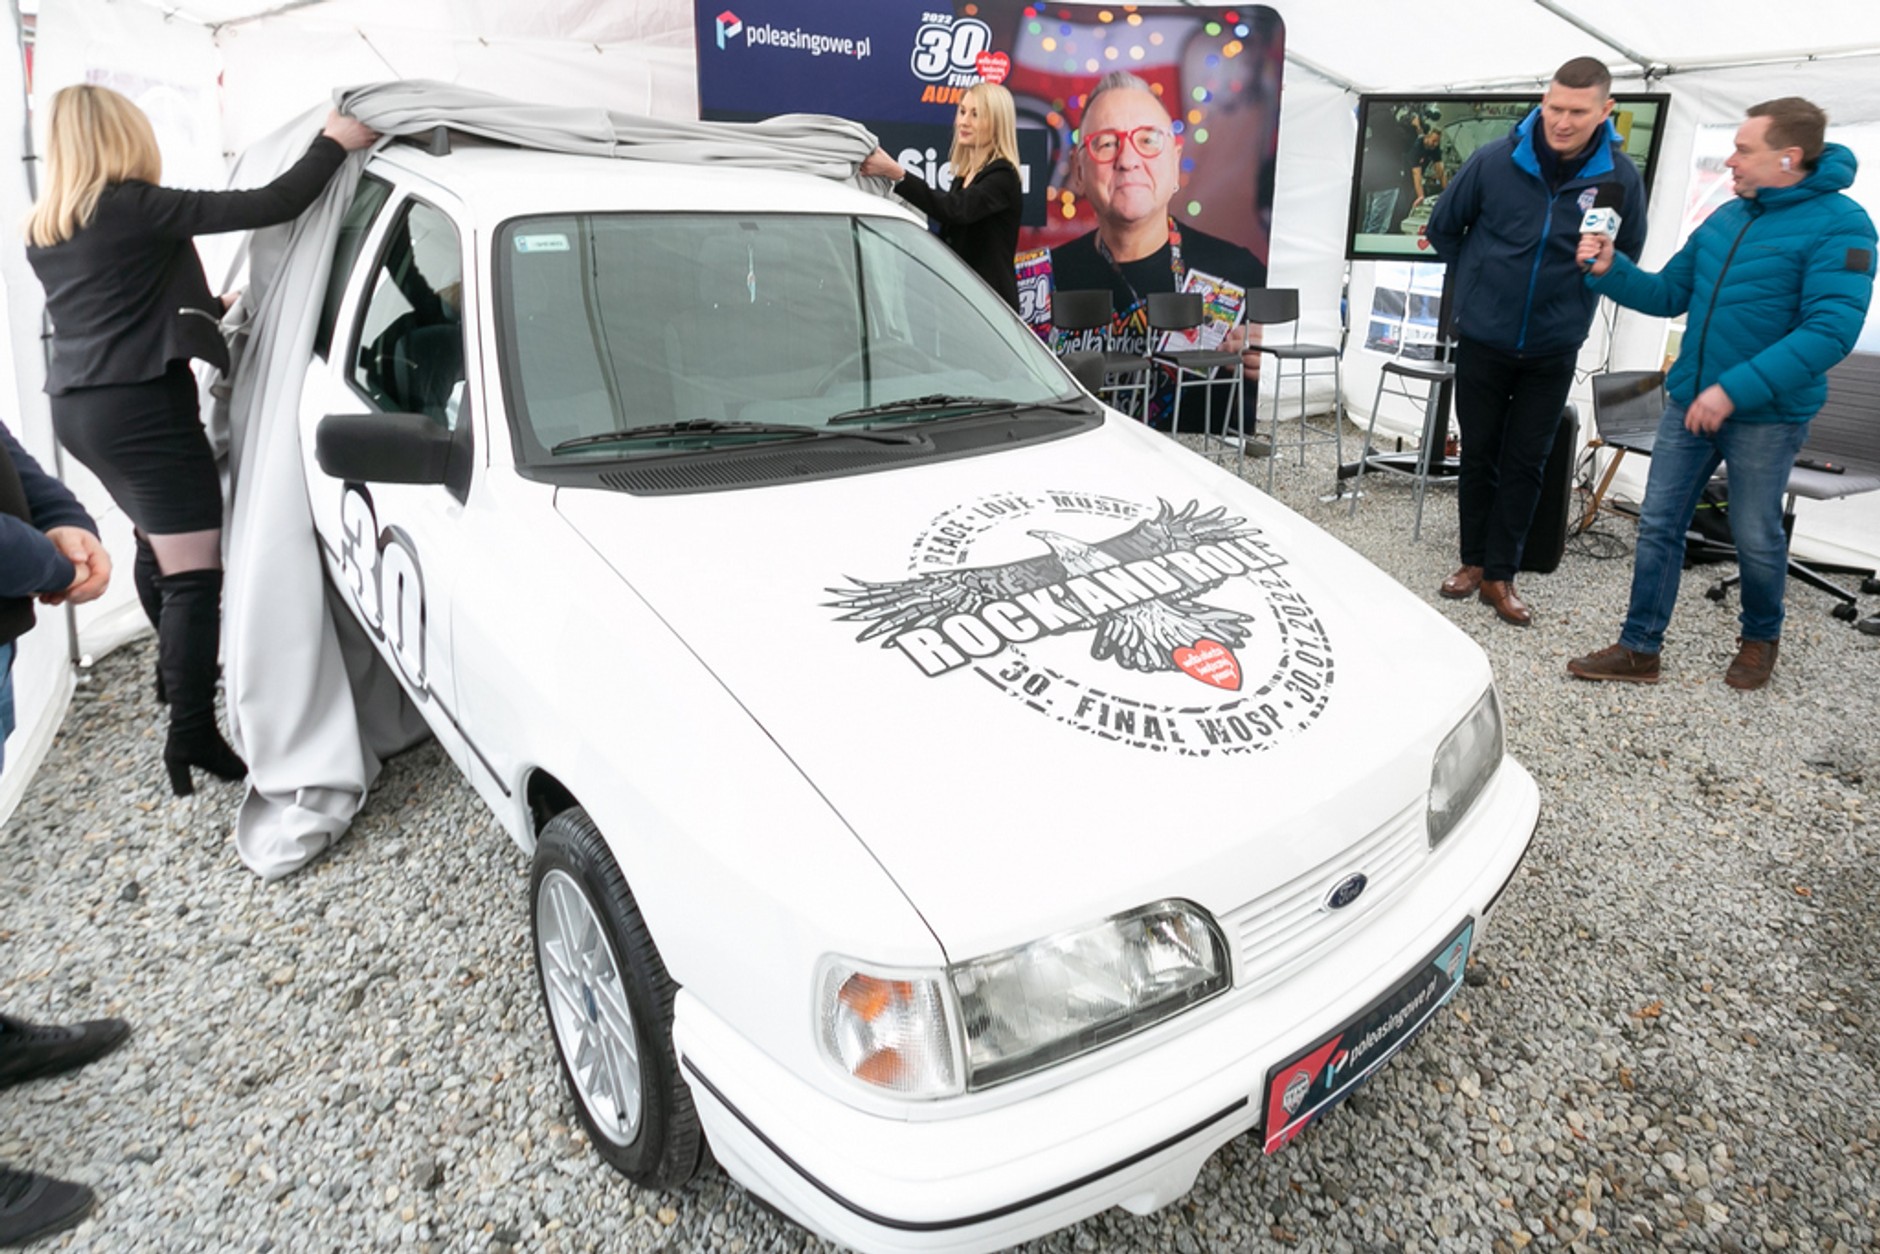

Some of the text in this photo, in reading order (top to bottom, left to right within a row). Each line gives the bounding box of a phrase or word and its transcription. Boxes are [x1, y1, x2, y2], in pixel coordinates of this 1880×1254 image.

[746, 23, 871, 60] poleasingowe.pl
[911, 18, 992, 82] 30
[923, 495, 1139, 566] PEACE LOVE MUSIC
[341, 481, 429, 704] 30
[1074, 695, 1186, 743] FINAL
[1195, 703, 1284, 745] WOSP
[1259, 579, 1325, 704] 30.01.2022
[1348, 974, 1438, 1068] poleasingowe.pl
